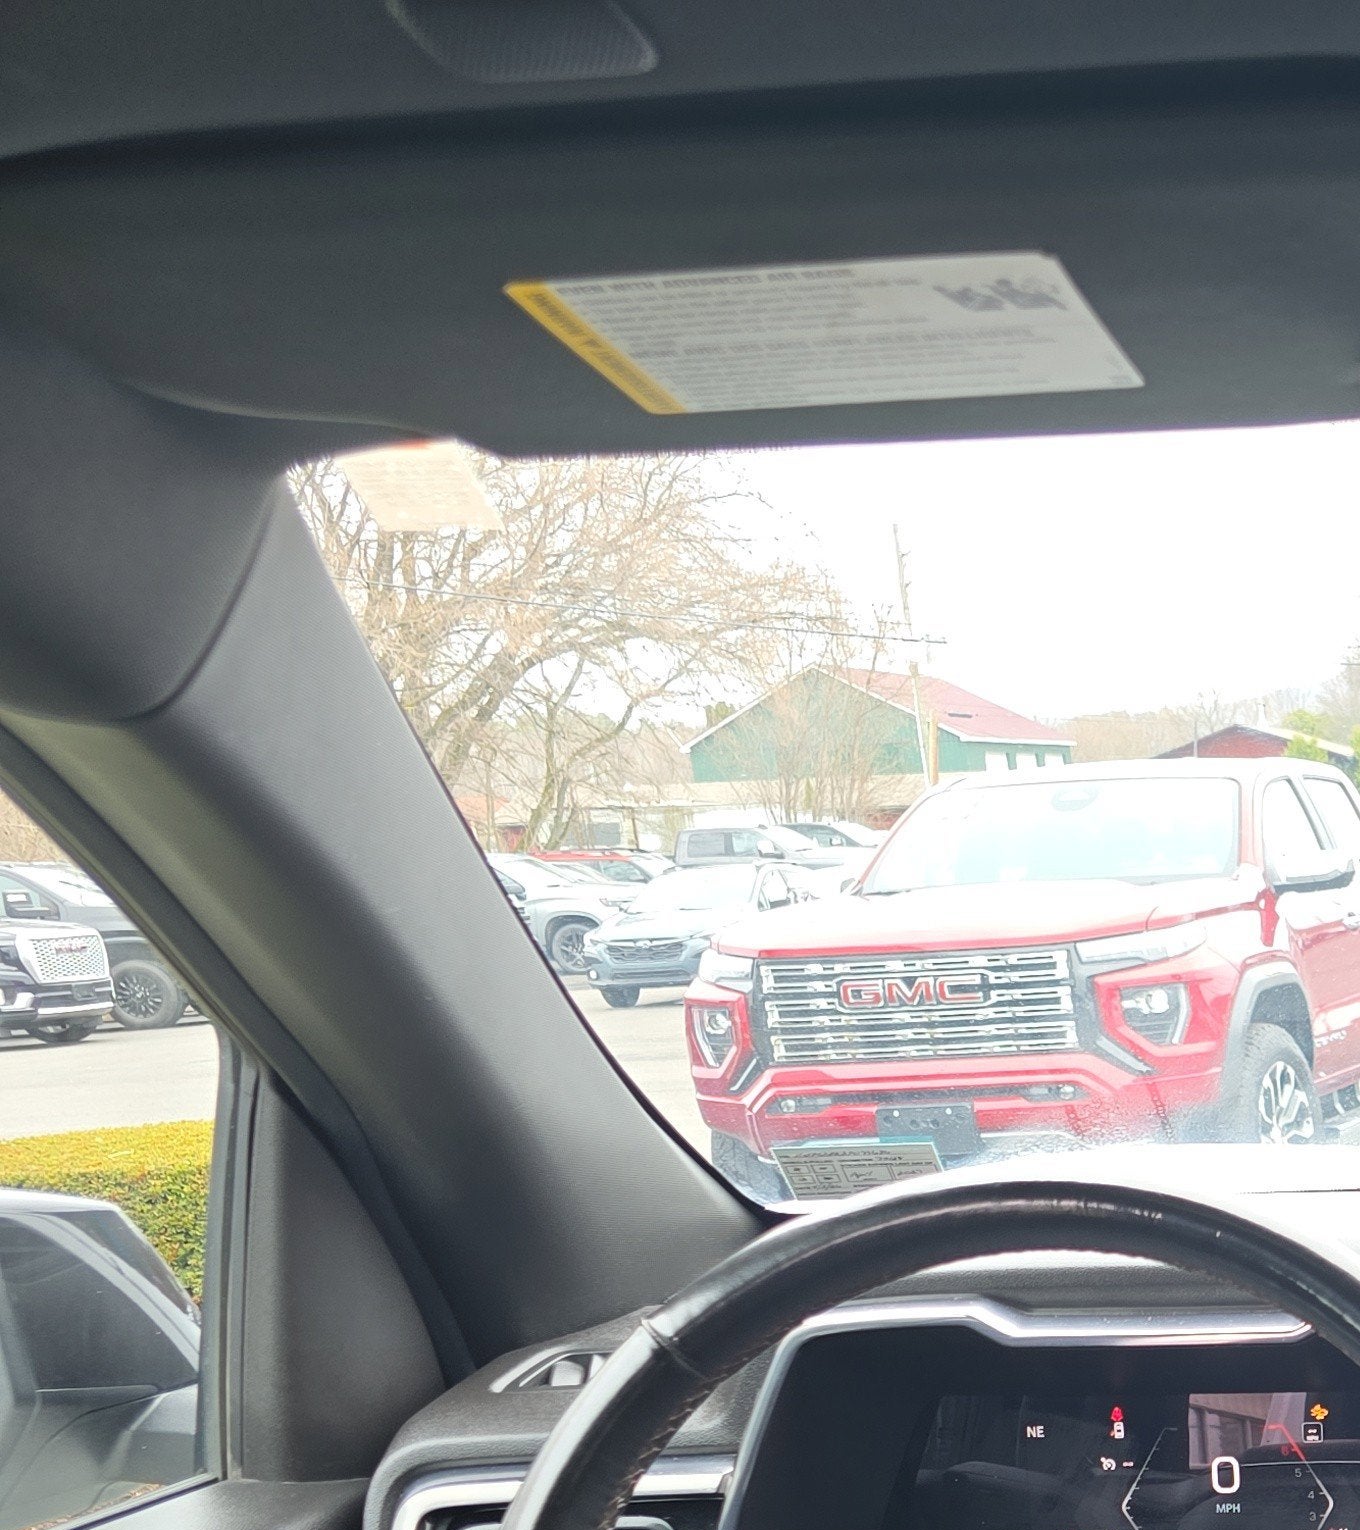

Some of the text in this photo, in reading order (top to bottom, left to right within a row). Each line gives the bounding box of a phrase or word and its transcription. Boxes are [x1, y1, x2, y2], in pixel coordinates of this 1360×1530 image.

[840, 974, 984, 1008] GMC
[1026, 1425, 1045, 1438] NE
[1294, 1468, 1303, 1478] 5
[1307, 1490, 1315, 1500] 4
[1216, 1503, 1241, 1514] MPH
[1308, 1511, 1317, 1521] 3
